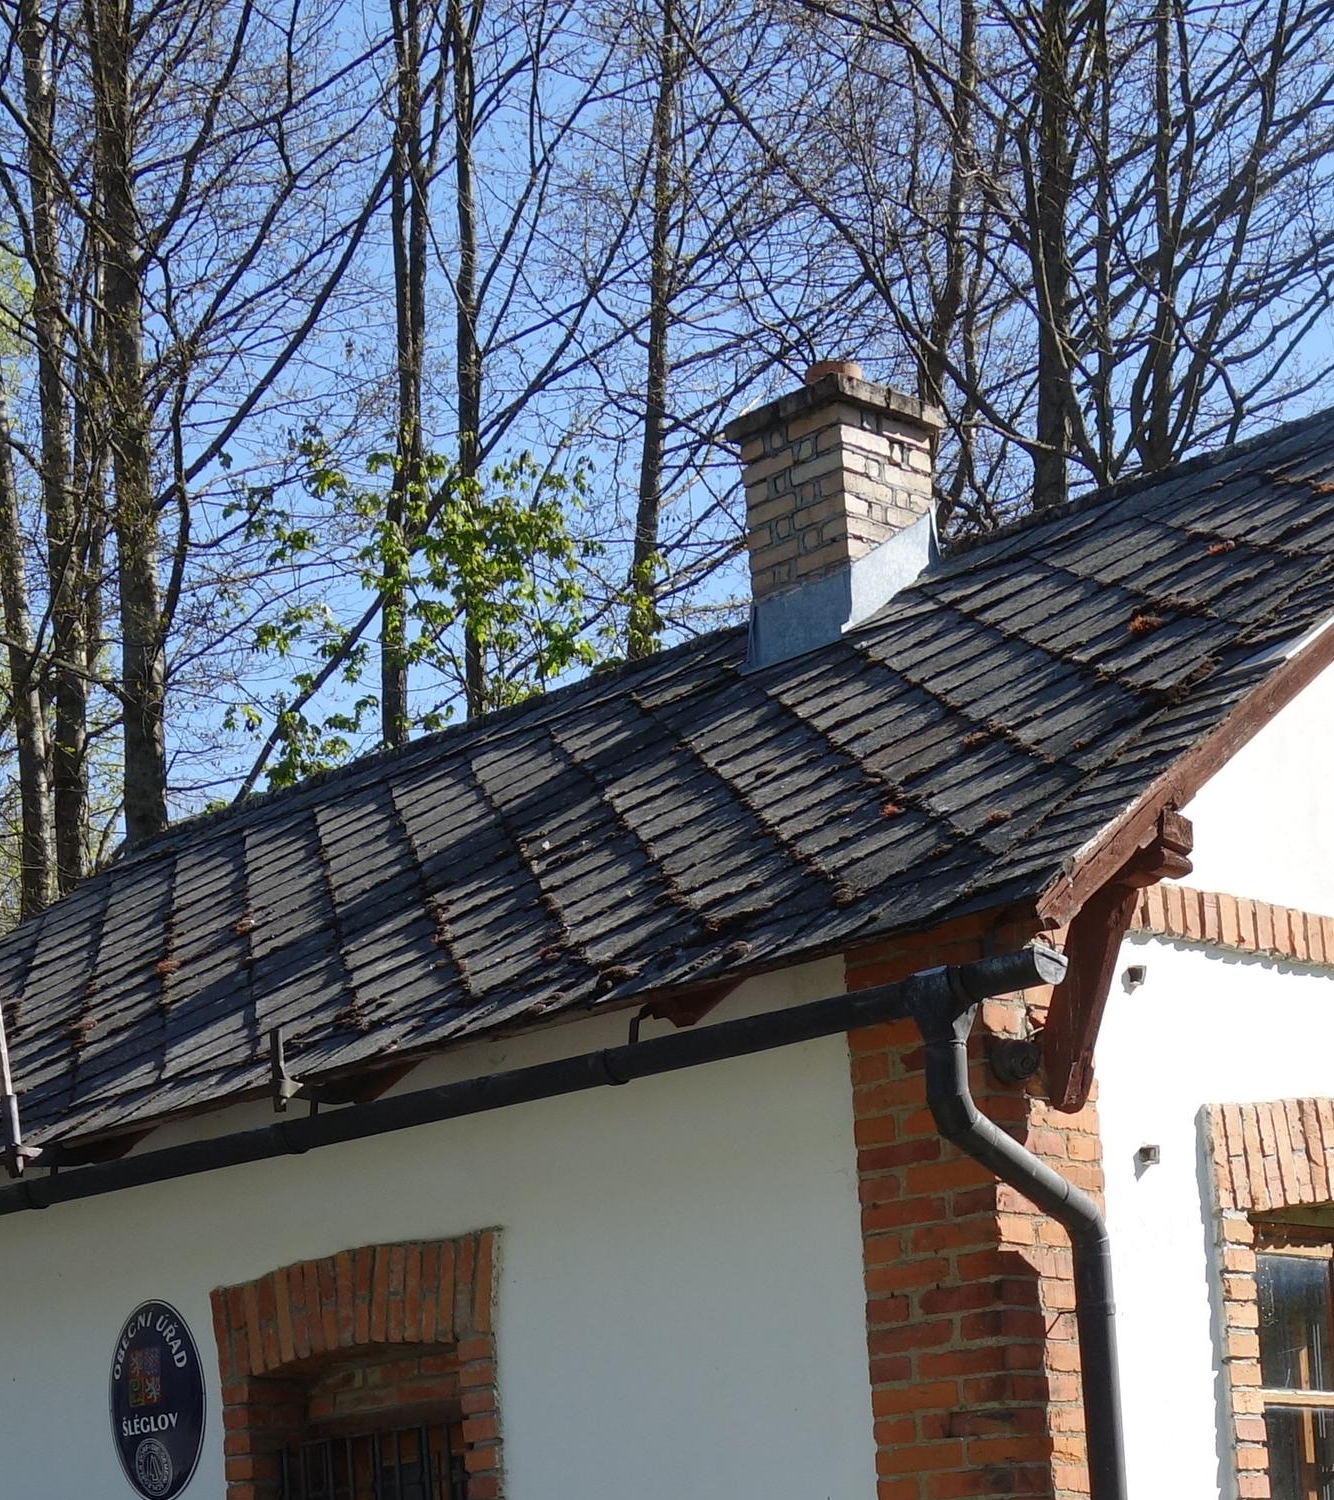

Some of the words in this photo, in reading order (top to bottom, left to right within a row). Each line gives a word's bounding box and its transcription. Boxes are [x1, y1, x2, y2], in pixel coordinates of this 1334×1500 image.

[114, 1311, 153, 1380] OBECNÍ
[156, 1313, 187, 1368] ÚŘAD
[122, 1411, 178, 1437] ŠLÉGLOV
